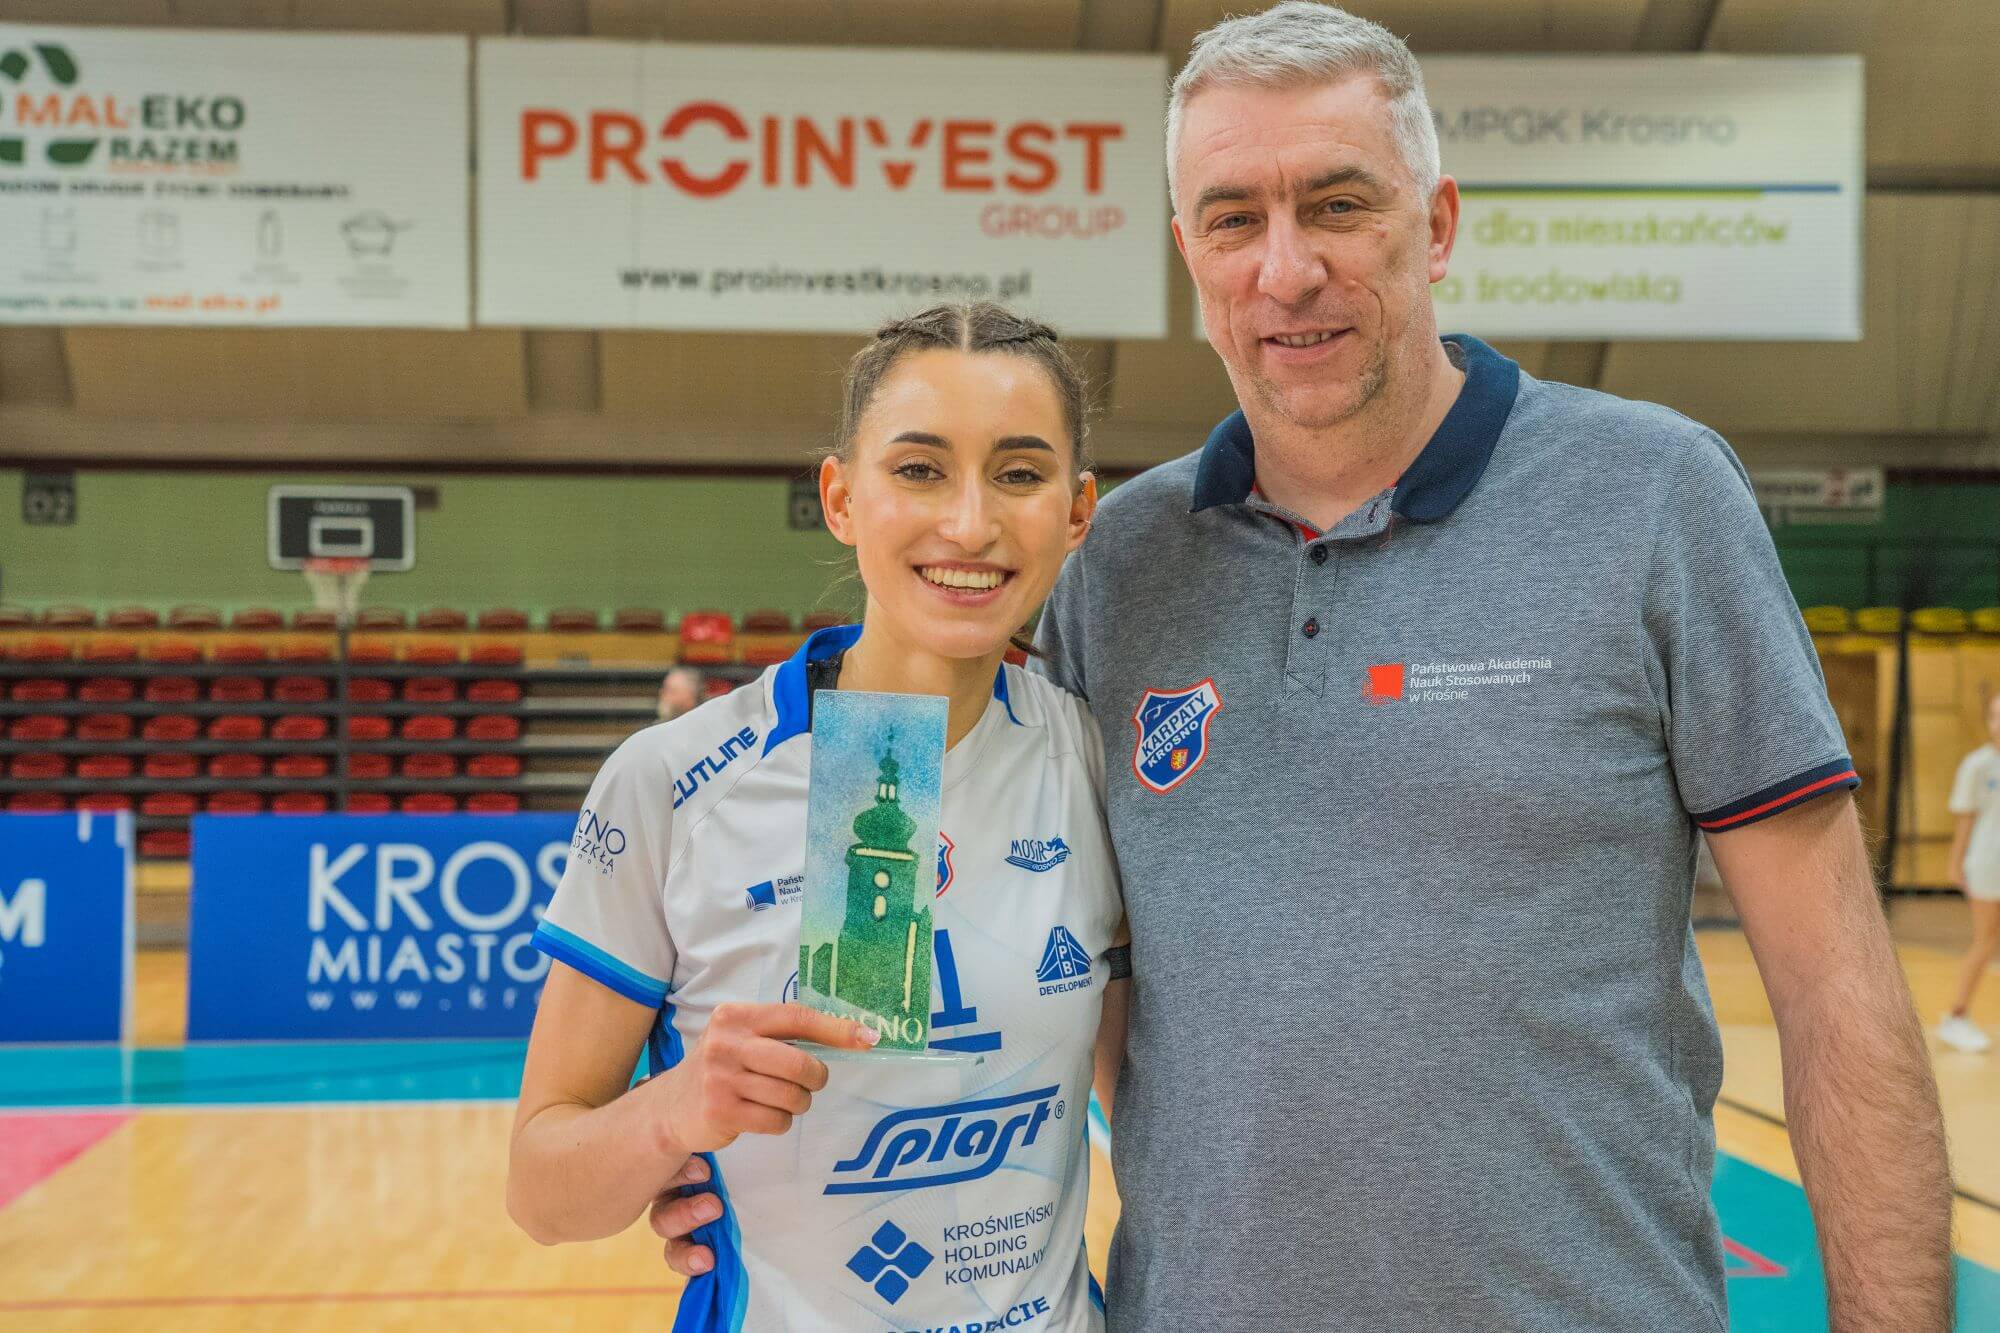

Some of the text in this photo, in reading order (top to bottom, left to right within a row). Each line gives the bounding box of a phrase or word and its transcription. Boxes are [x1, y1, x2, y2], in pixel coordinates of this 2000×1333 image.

[1581, 109, 1740, 146] Krosno
[108, 137, 240, 164] RAZEM
[519, 99, 1125, 200] PROINVEST
[980, 203, 1126, 239] GROUP
[1473, 206, 1790, 246] dla mieszkańców
[1476, 264, 1684, 305] środowiska
[1410, 672, 1532, 688] Nauk Stosowanych
[1411, 657, 1553, 675] Państwowa Akademia
[1409, 689, 1469, 702] w Krośnie
[1141, 691, 1207, 758] KARPATY
[1147, 720, 1199, 769] KROSNO
[778, 886, 802, 896] Nauk
[1039, 976, 1093, 996] DEVELOPMENT
[943, 1201, 1054, 1243] KROŚNIEŃSKI
[944, 1234, 1028, 1264] HOLDING
[945, 1248, 1046, 1286] KOMUNALNY
